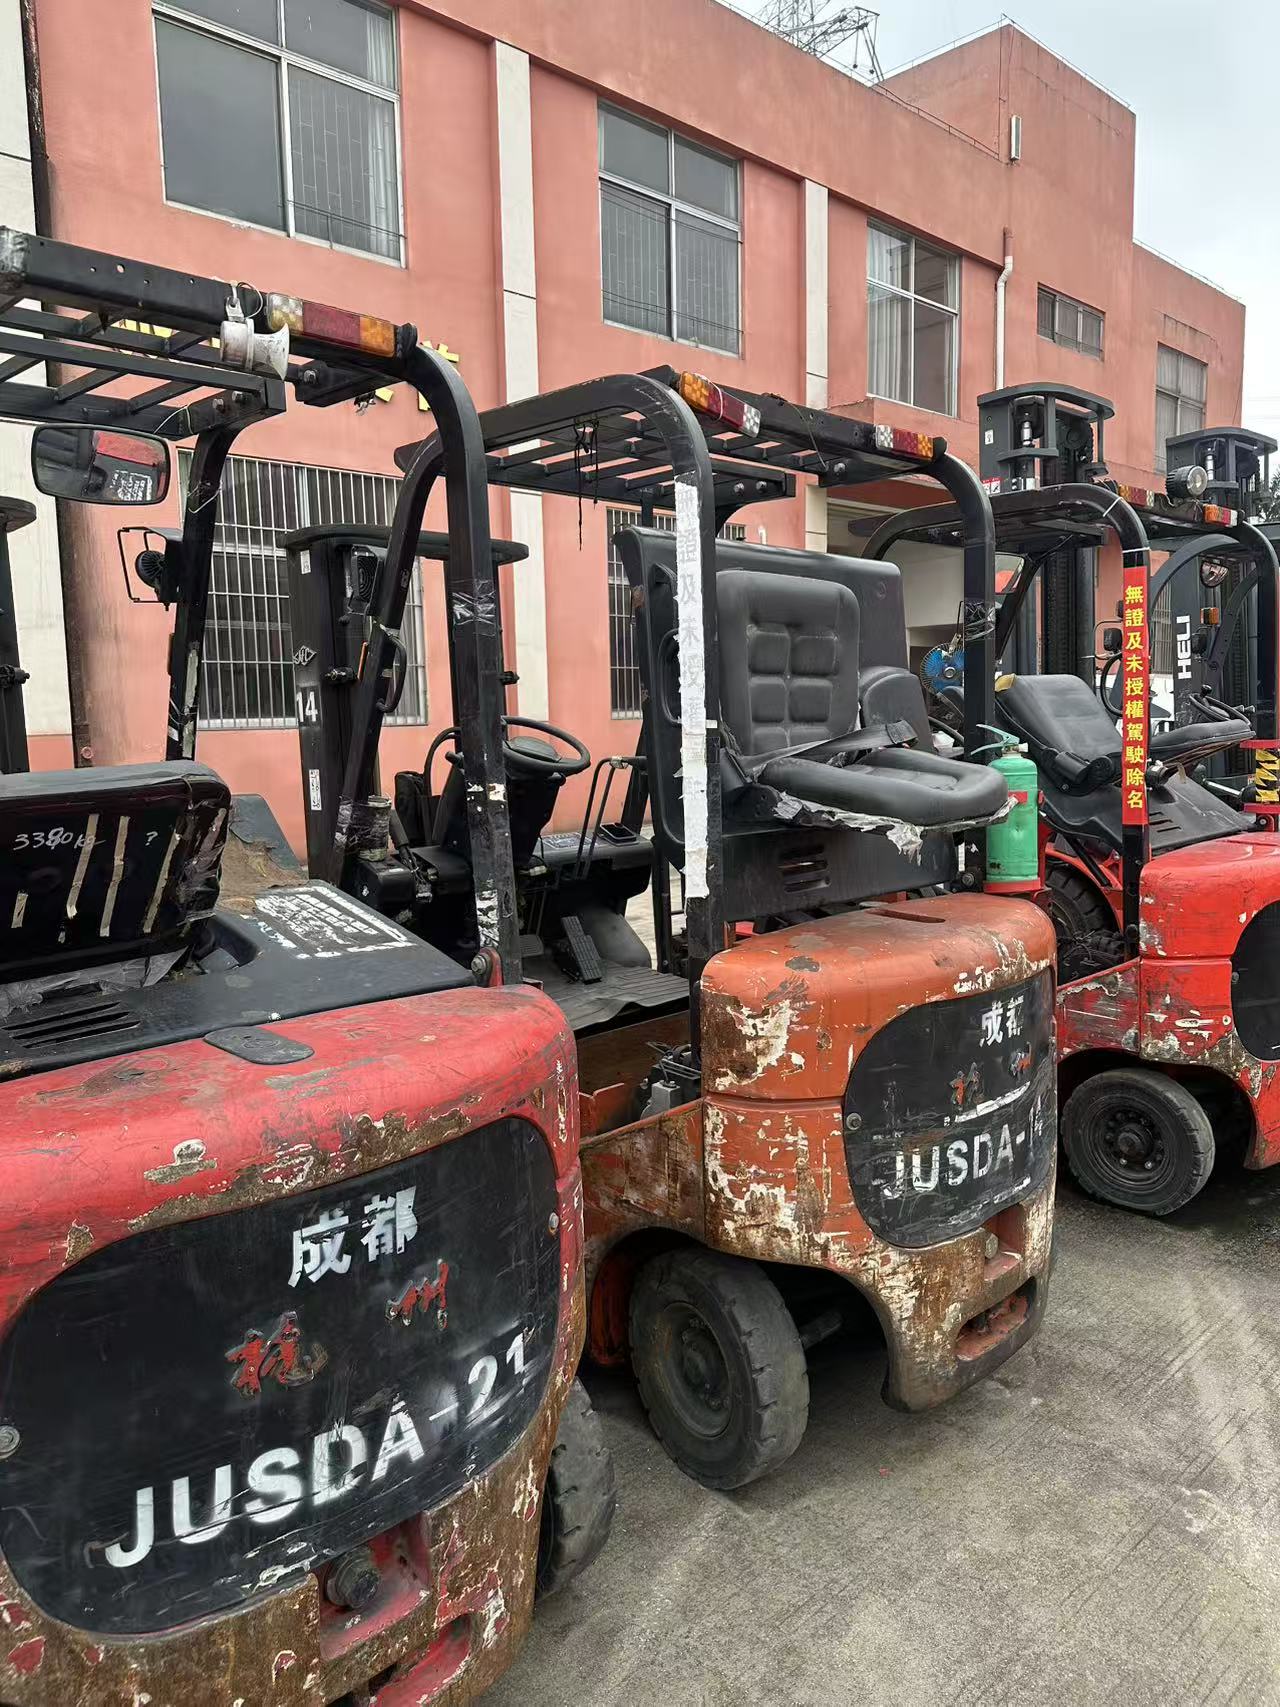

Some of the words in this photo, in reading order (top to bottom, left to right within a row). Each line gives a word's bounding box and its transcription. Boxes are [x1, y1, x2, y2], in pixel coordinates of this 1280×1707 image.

[1125, 585, 1145, 808] 無證及未授權駕駛除名
[1176, 615, 1192, 680] HELI
[296, 691, 318, 722] 14
[288, 1186, 418, 1287] 成都
[105, 1328, 532, 1568] JUSDA-21
